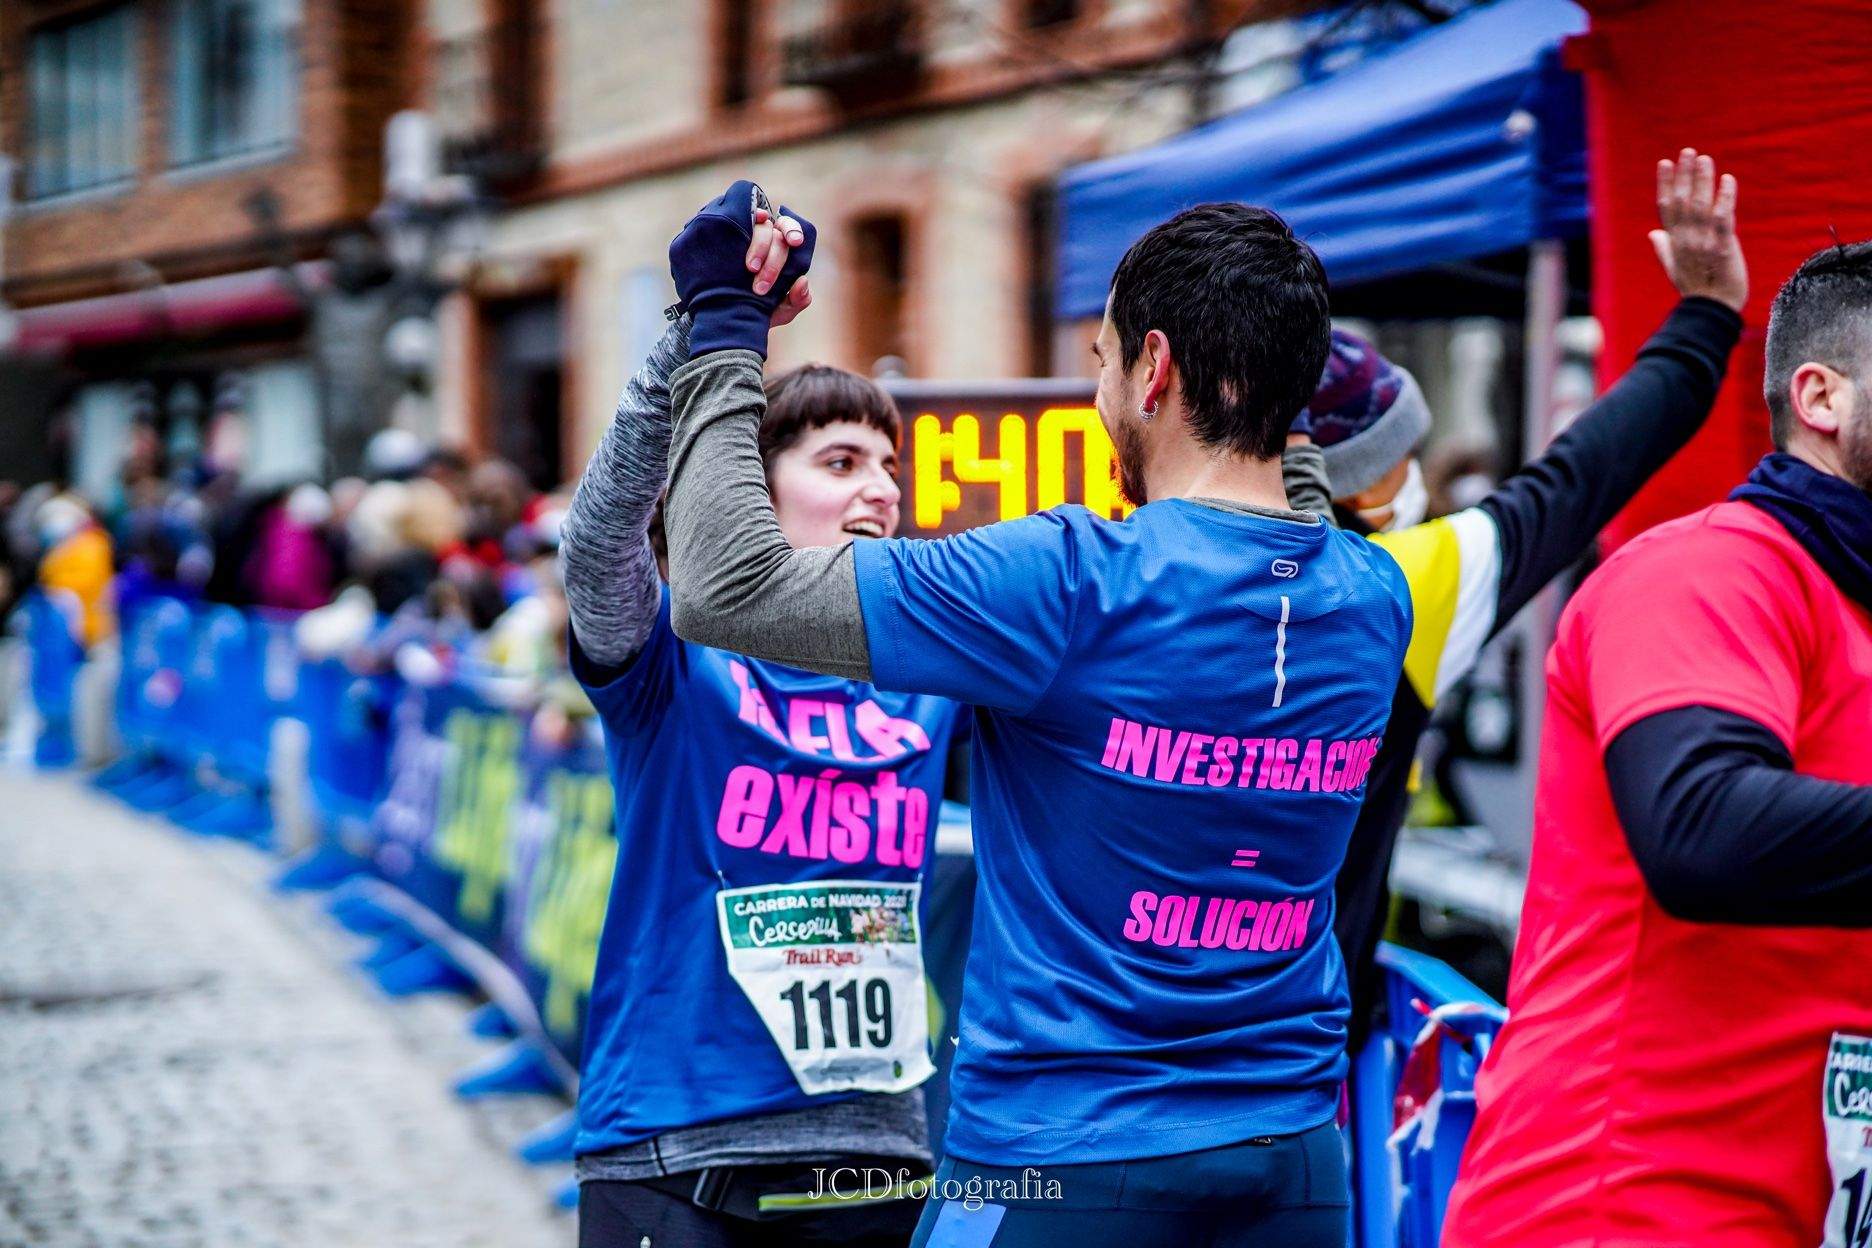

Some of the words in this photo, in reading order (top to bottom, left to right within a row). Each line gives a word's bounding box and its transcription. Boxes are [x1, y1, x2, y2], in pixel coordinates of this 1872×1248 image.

[733, 894, 809, 917] CARRERA
[828, 893, 882, 909] NAVIDAD
[1123, 891, 1315, 952] SOLUCIÓN
[782, 948, 821, 965] Trail
[780, 977, 893, 1051] 1119
